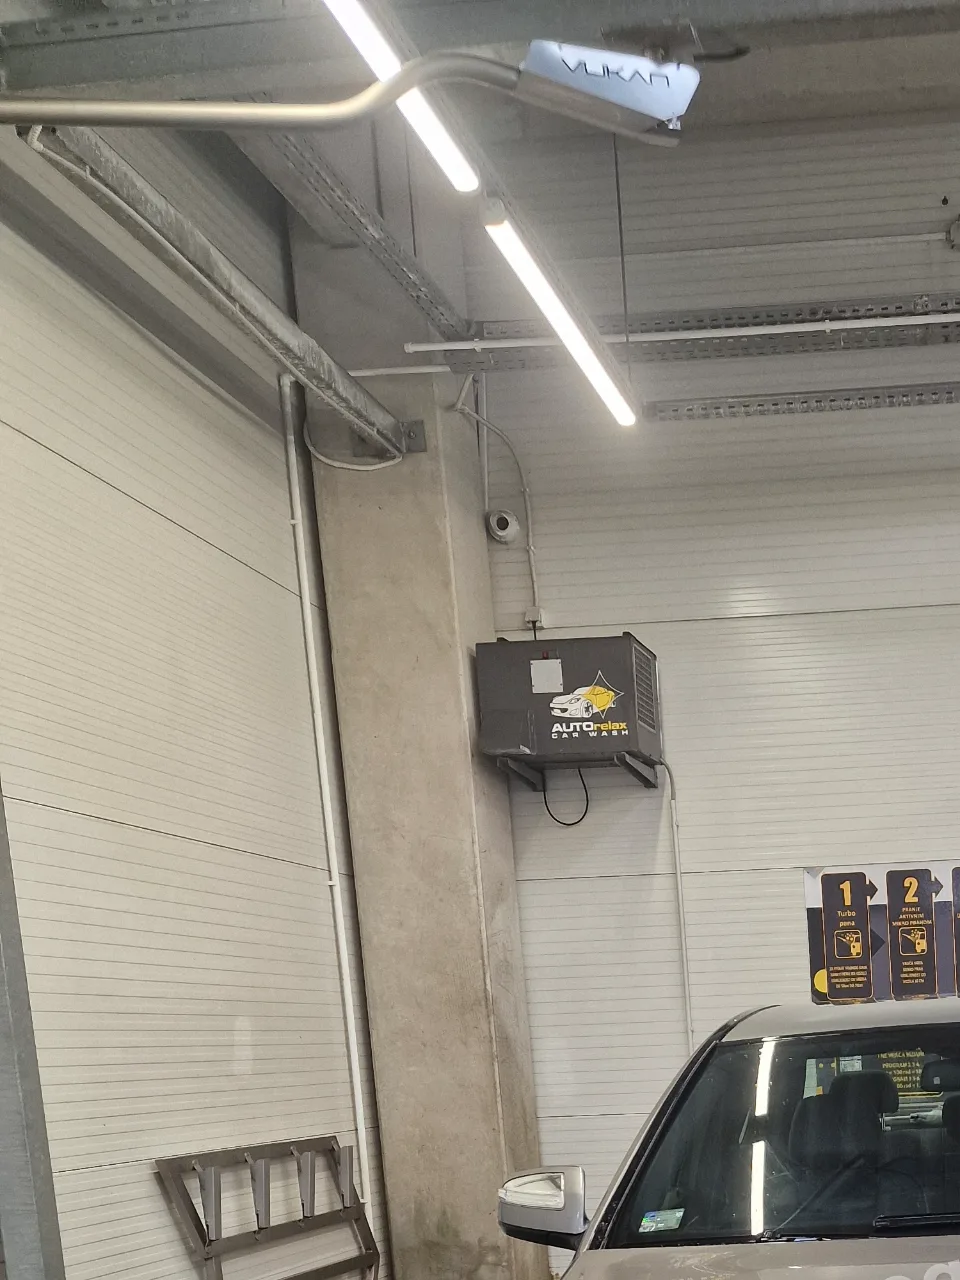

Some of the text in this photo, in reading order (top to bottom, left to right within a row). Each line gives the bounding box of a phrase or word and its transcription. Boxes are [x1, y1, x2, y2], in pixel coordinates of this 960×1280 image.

[588, 730, 629, 738] WASH
[839, 880, 852, 906] 1
[903, 877, 919, 903] 2
